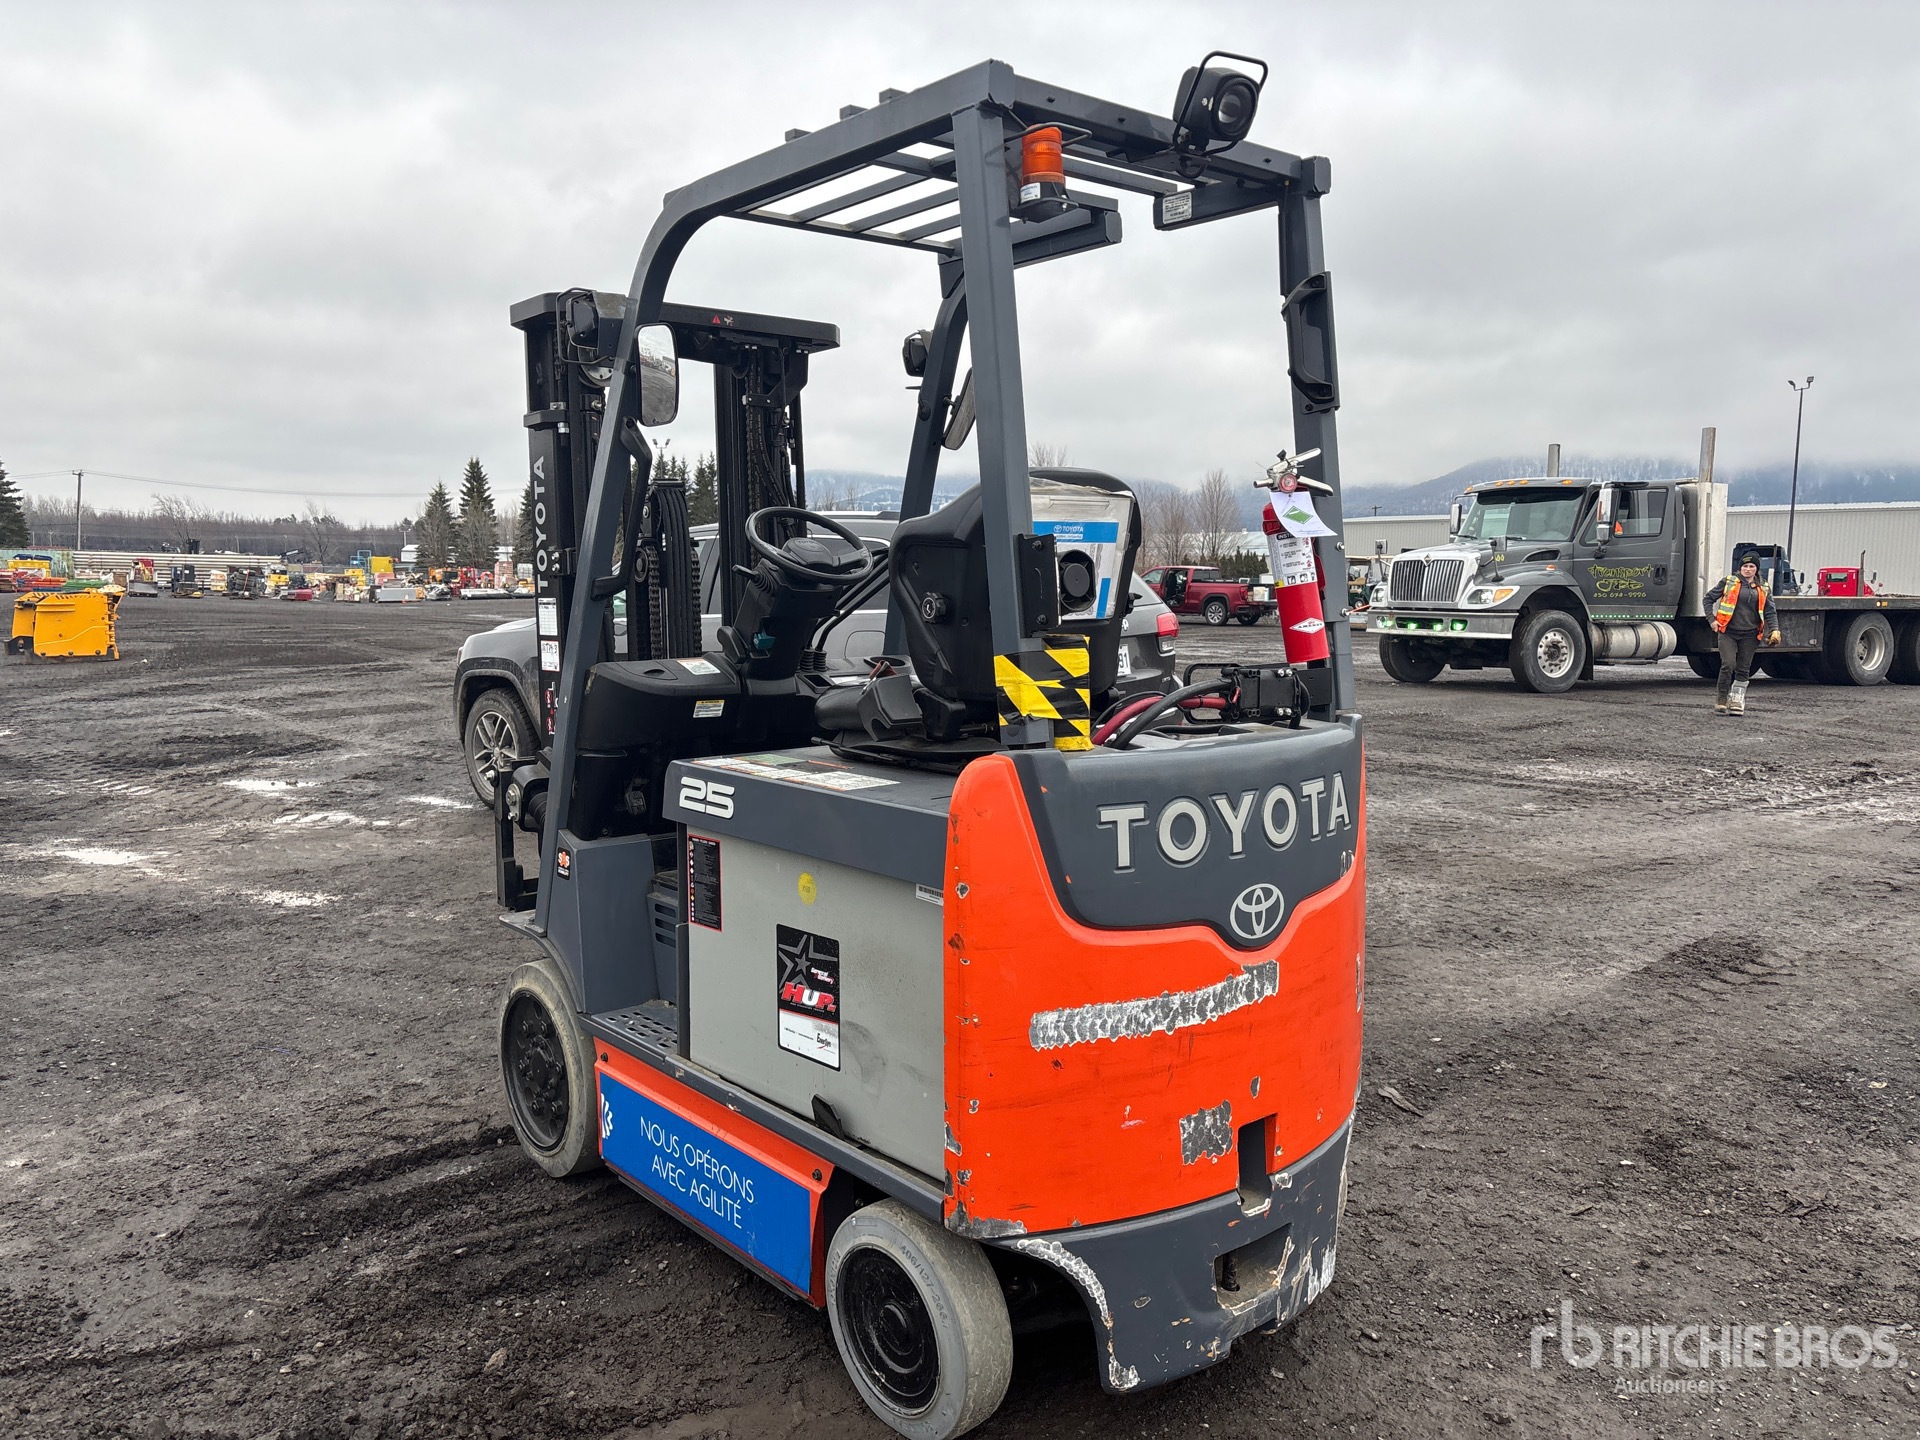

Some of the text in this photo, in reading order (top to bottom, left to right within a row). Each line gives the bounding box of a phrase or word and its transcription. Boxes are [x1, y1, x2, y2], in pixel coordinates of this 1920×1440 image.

[533, 455, 548, 593] TOYOTA
[1062, 525, 1083, 533] TOYOTA
[679, 776, 735, 820] 25
[1098, 771, 1351, 870] TOYOTA
[640, 1116, 755, 1203] NOUS OPÉRONS
[651, 1154, 742, 1229] AVEC AGILITÉ
